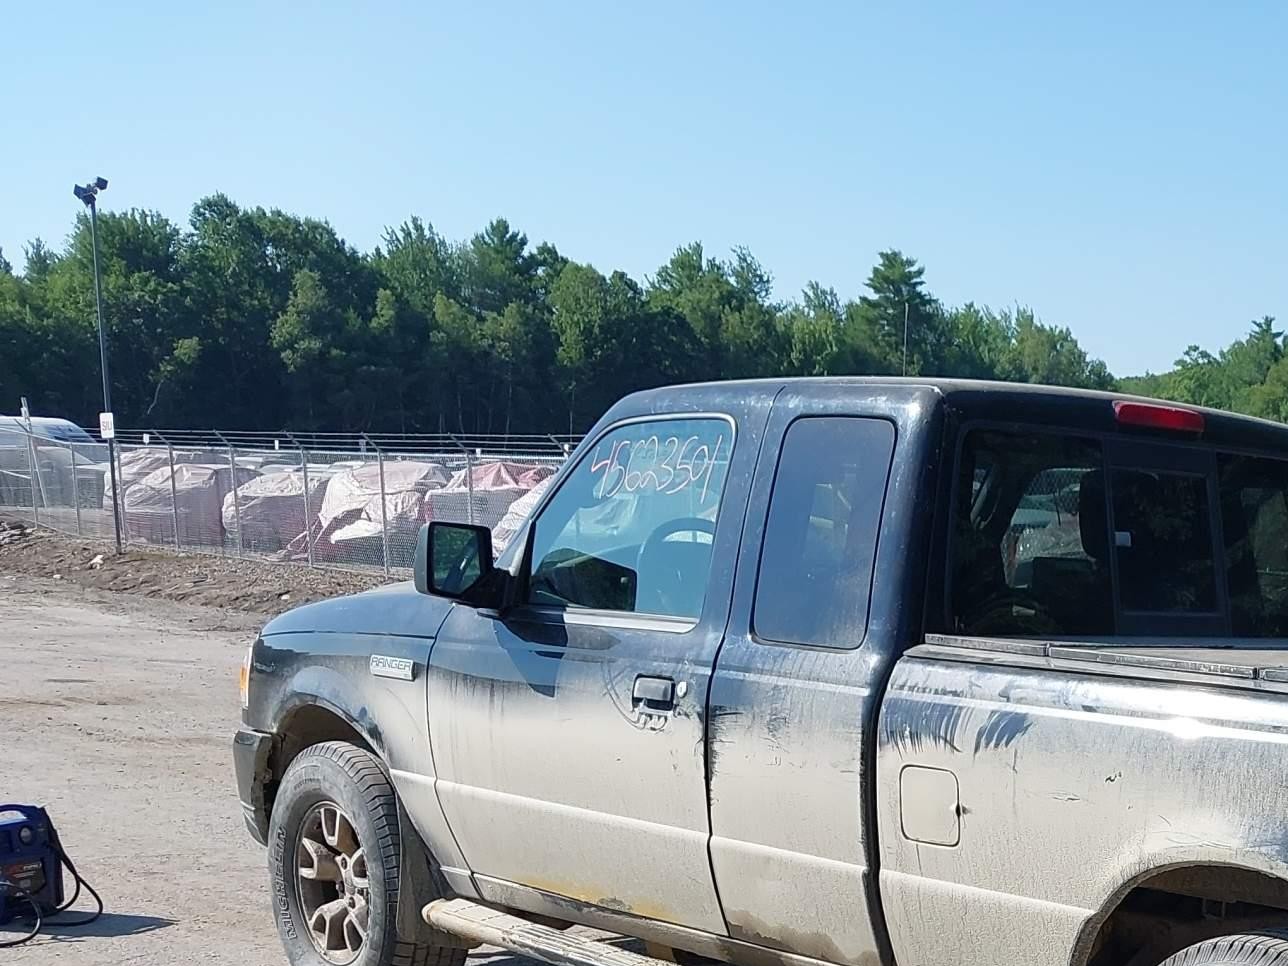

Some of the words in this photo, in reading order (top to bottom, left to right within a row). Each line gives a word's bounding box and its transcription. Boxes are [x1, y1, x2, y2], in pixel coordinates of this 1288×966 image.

[591, 435, 723, 504] 45623501
[371, 657, 411, 671] RANGER
[278, 824, 298, 940] MICHELIN
